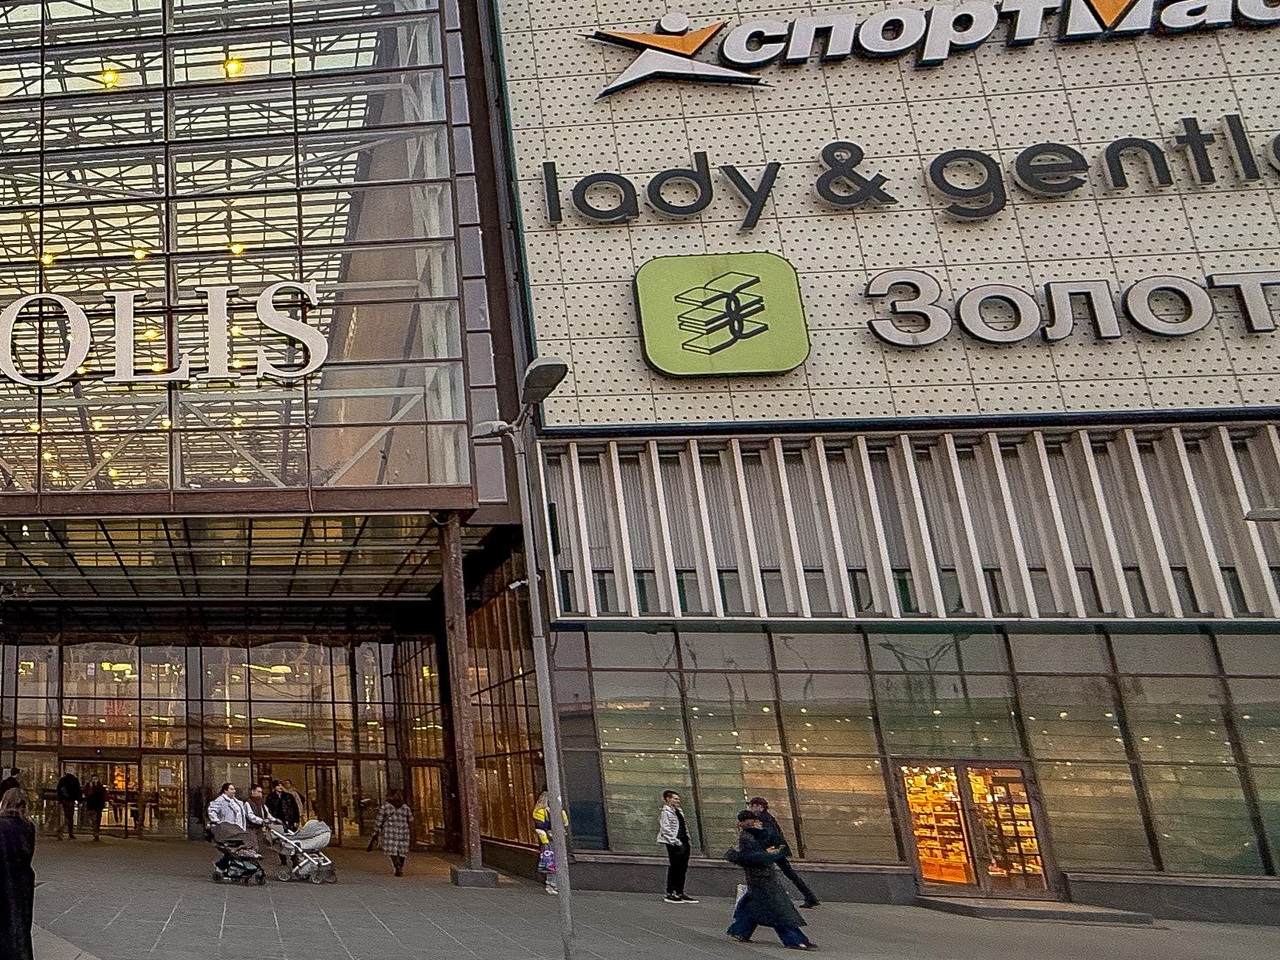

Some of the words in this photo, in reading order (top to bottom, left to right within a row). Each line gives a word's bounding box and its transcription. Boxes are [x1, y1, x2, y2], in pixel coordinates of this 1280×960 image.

[542, 150, 781, 231] lady
[815, 141, 899, 206] &
[928, 113, 1280, 221] gentl
[863, 269, 1280, 348] Золот
